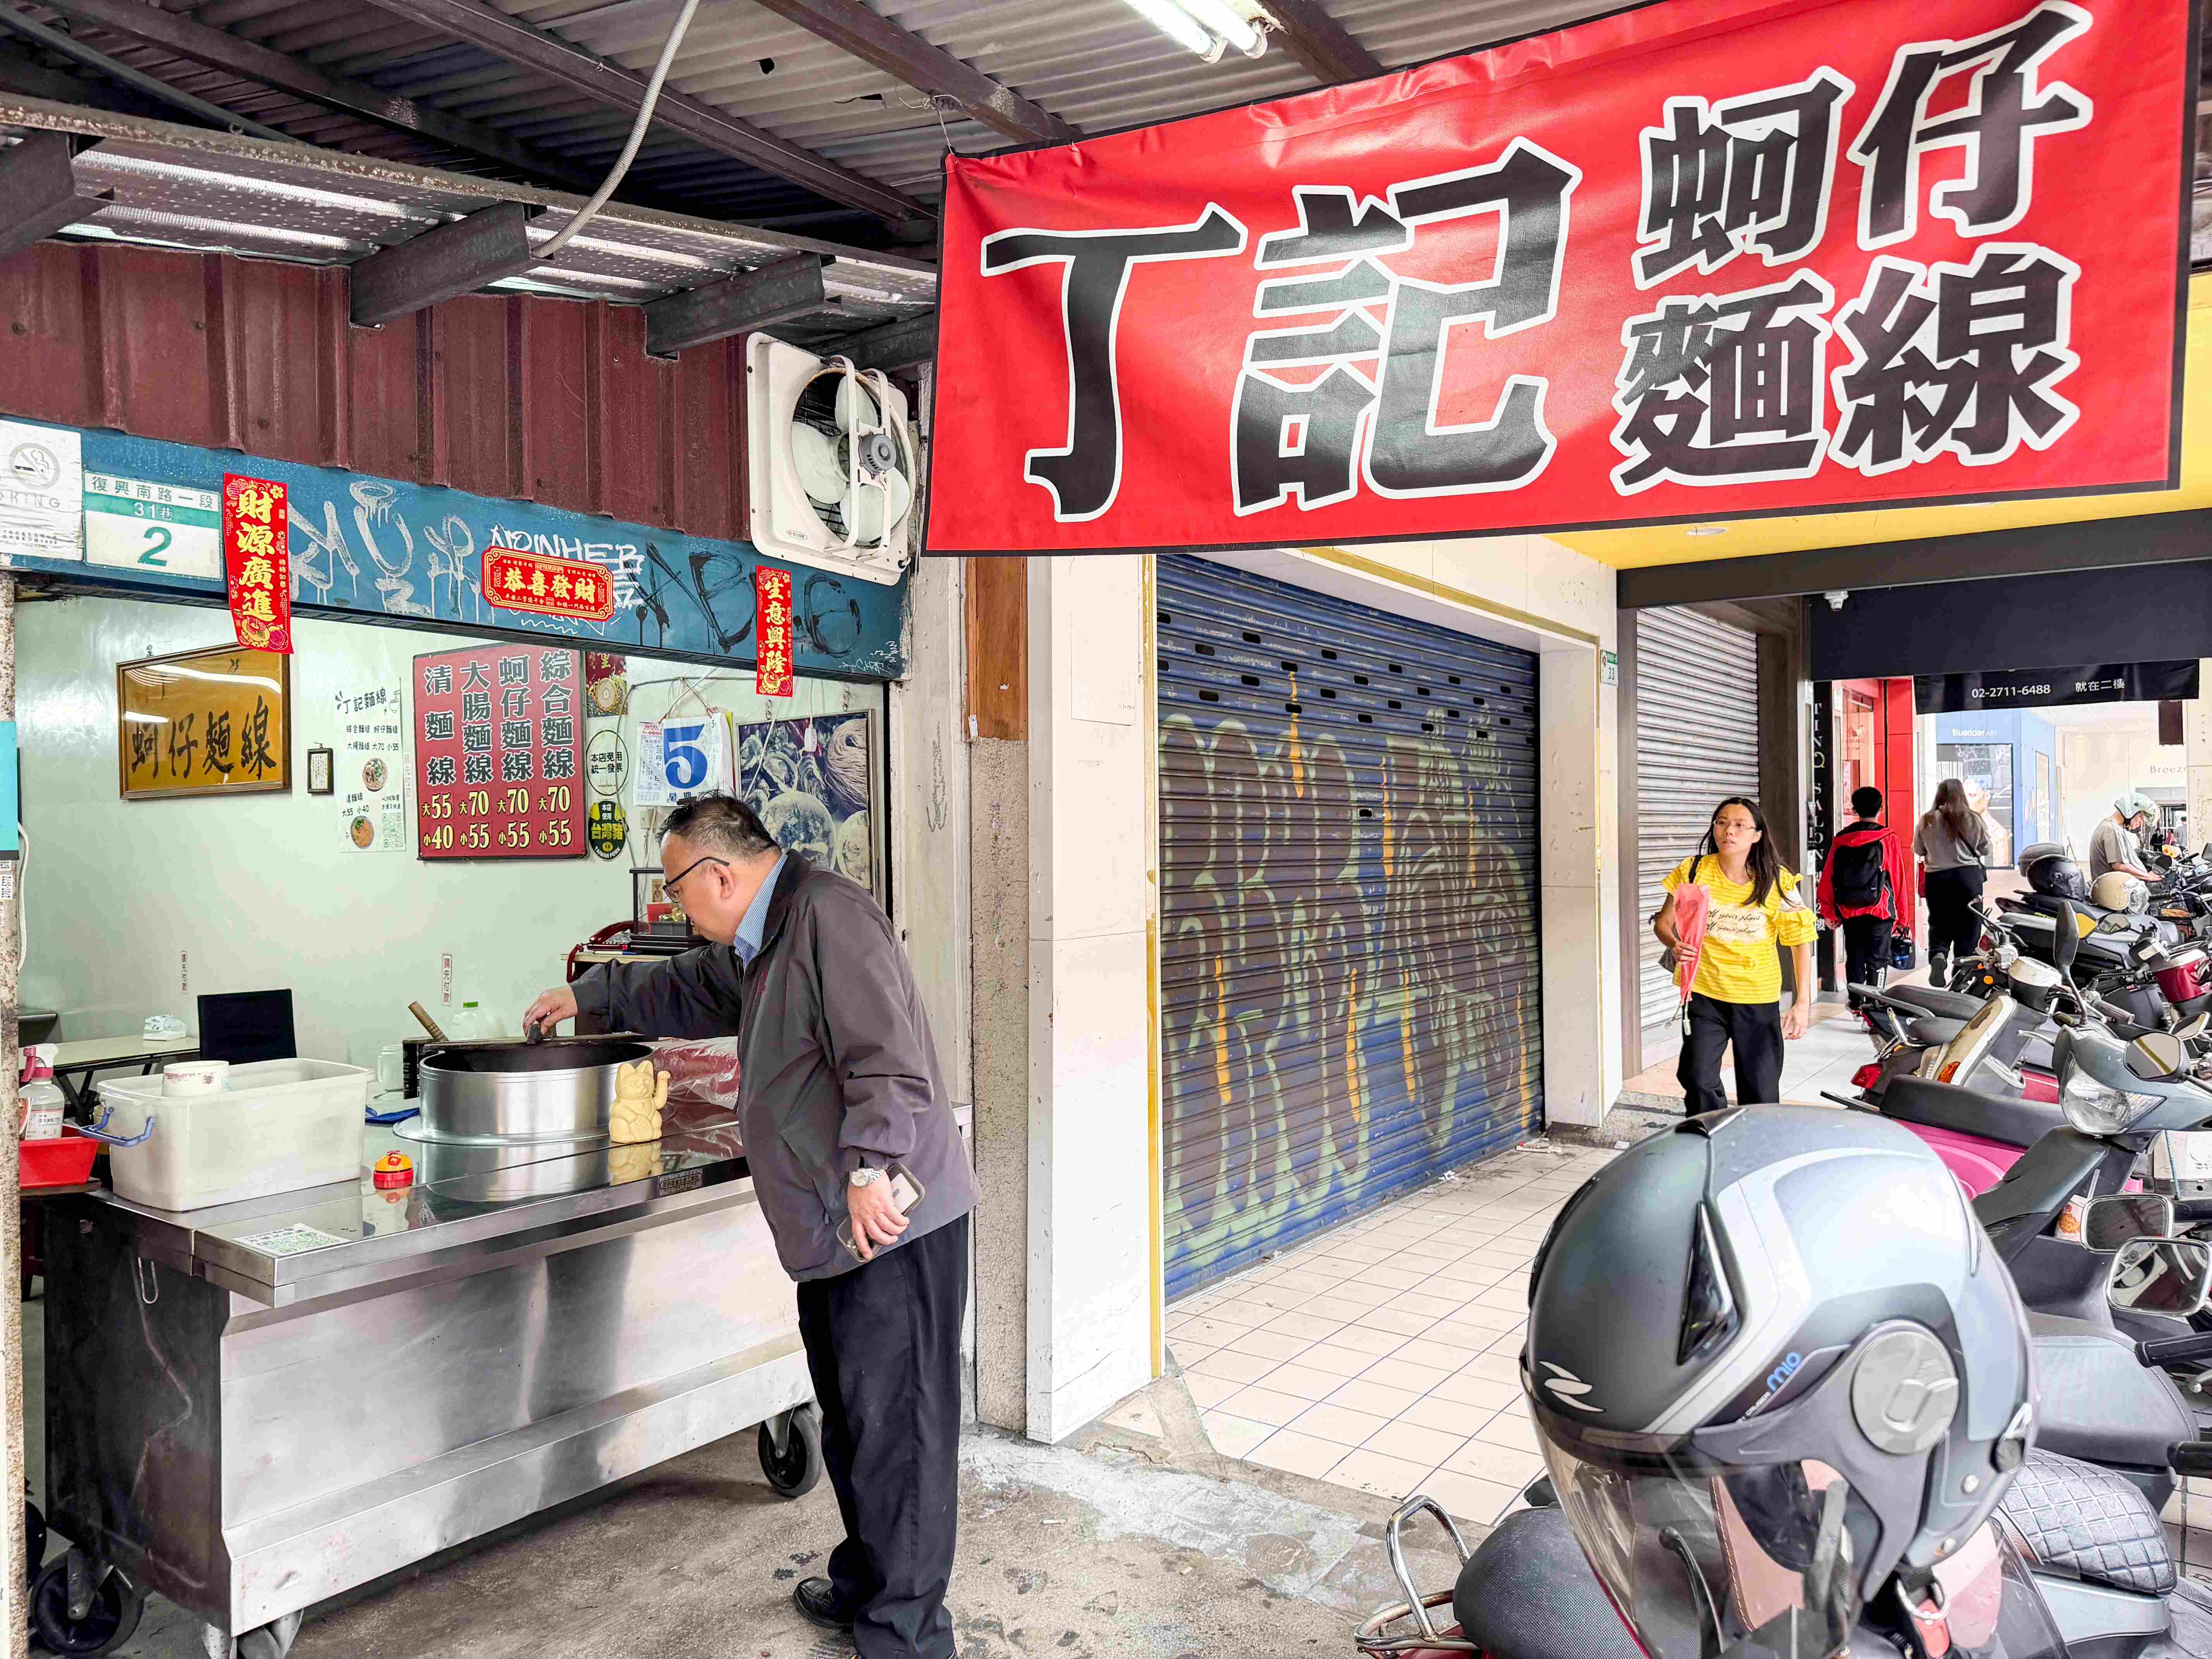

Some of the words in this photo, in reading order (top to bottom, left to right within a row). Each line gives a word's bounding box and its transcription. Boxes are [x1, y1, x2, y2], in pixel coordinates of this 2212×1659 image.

[1630, 1, 2095, 290] 蚵仔
[981, 137, 1582, 524] 丁記
[1612, 246, 2080, 496] 麵線
[91, 477, 213, 509] 復興南路一段
[133, 502, 173, 520] 31巷
[138, 527, 172, 567] 2
[236, 489, 278, 622] 財源廣進
[503, 567, 596, 604] 恭喜發財
[764, 577, 787, 673] 生意興隆
[343, 687, 386, 714] 丁記麵線
[1972, 684, 2051, 698] 02-2711-6488
[2075, 678, 2125, 692] 就在二樓
[424, 665, 456, 786] 清麵線
[459, 661, 493, 785] 大腸麵線
[498, 654, 533, 782] 蚵仔麵線
[540, 649, 575, 780] 綜合麵線
[131, 695, 277, 780] 蚵仔麵線
[591, 752, 622, 762] 本店免用
[591, 763, 623, 774] 統一發票
[663, 724, 708, 789] 5
[422, 794, 452, 819] 大55
[459, 790, 489, 816] 大70
[497, 788, 529, 814] 大70
[538, 786, 570, 812] 大70
[423, 824, 453, 850] 小40
[459, 823, 490, 848] 小55
[498, 821, 530, 848] 小55
[539, 818, 572, 846] 小55
[591, 823, 623, 840] 台灣豬
[594, 846, 609, 858] TAIWAN
[610, 846, 620, 858] PORK
[1767, 1352, 1801, 1391] mio
